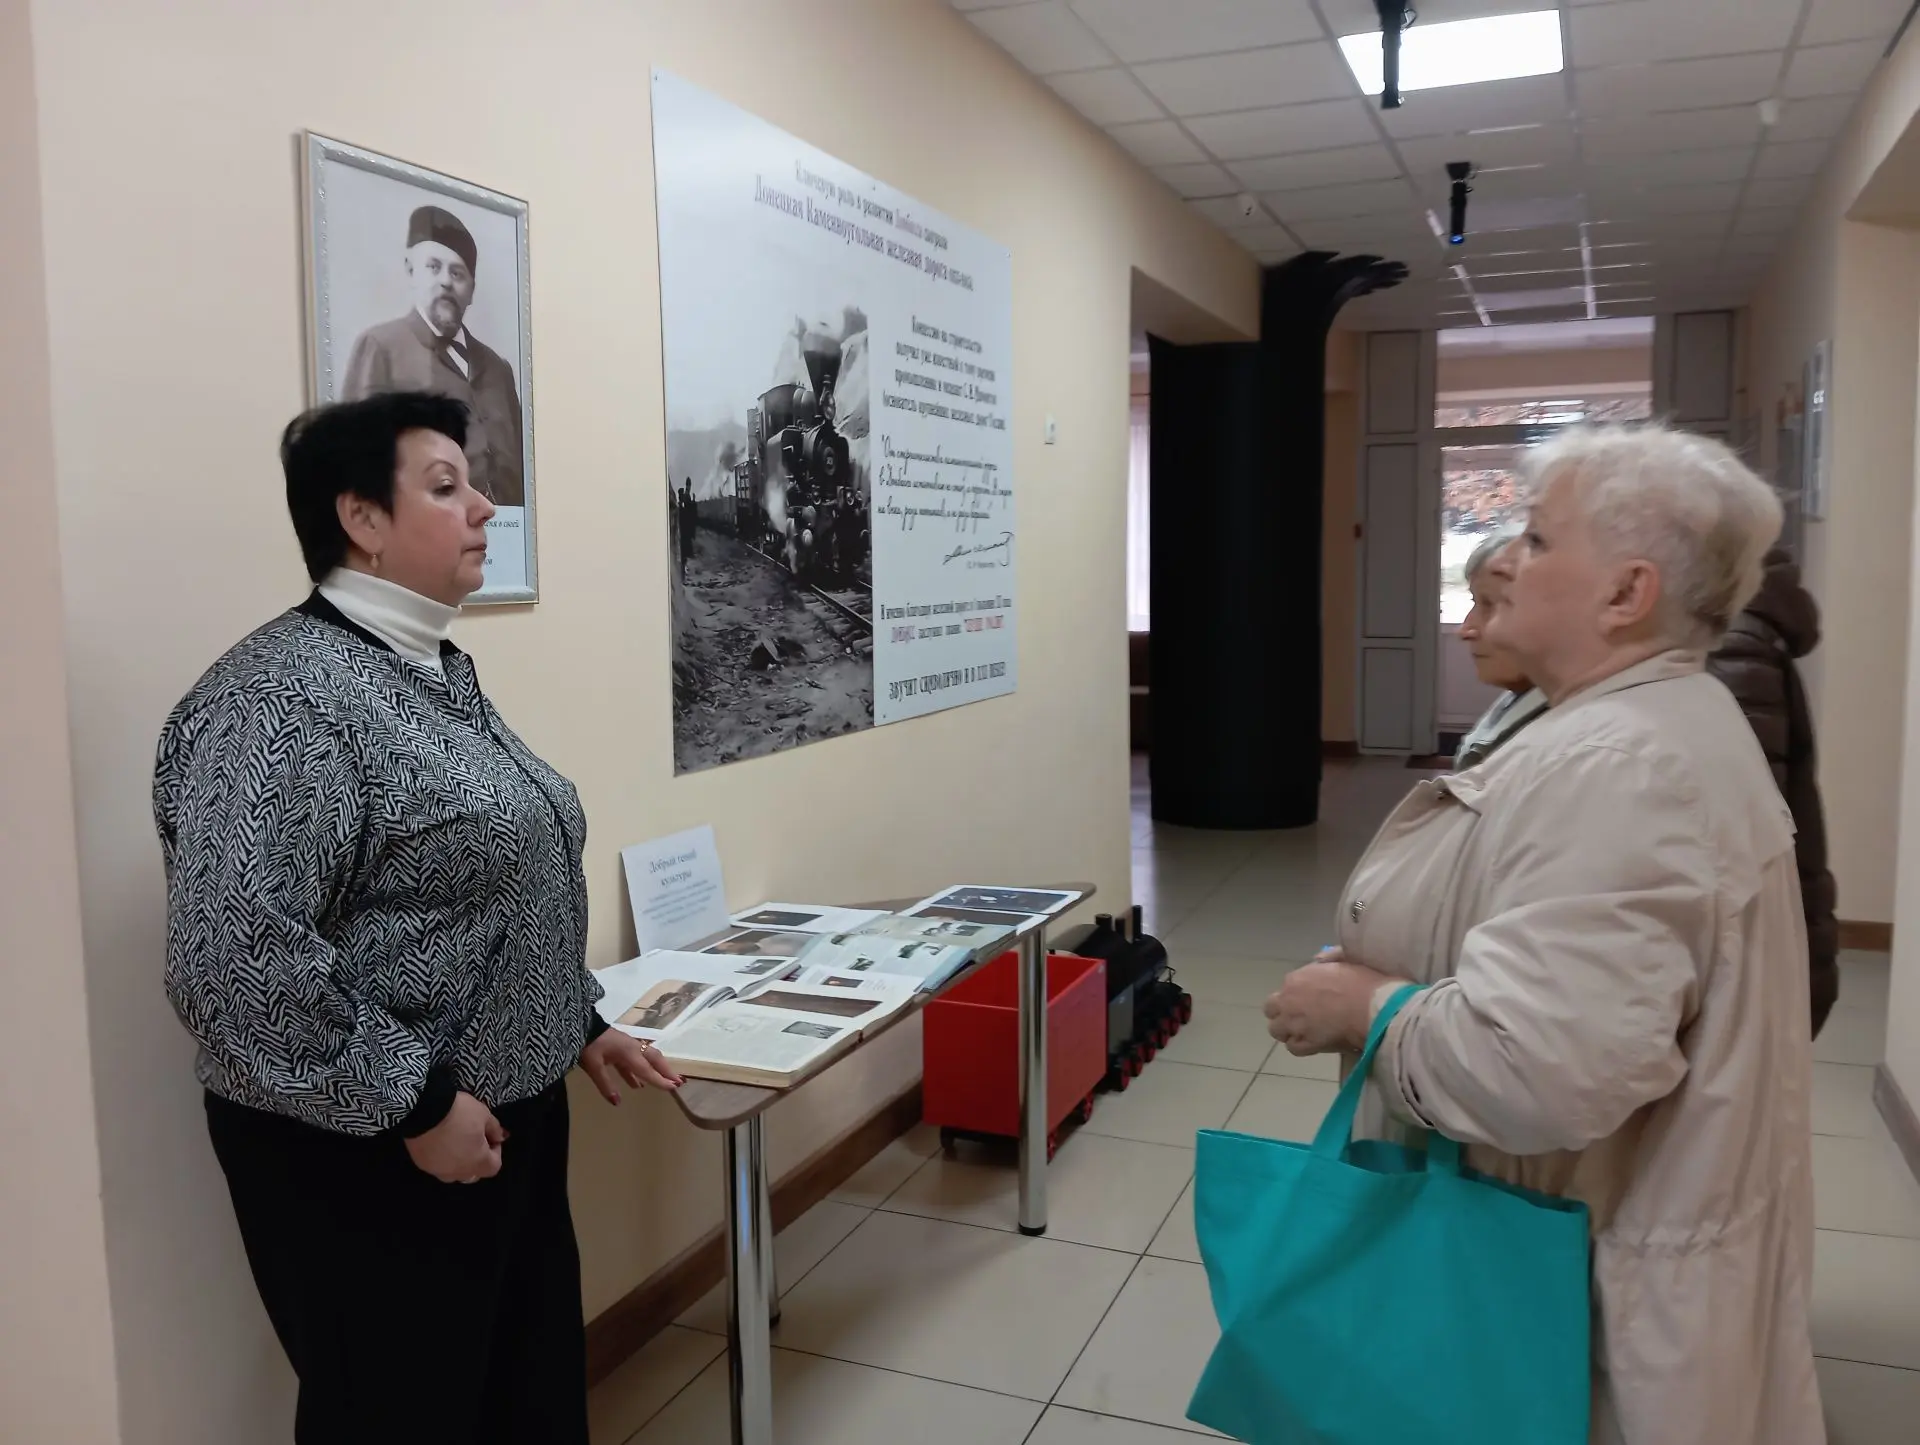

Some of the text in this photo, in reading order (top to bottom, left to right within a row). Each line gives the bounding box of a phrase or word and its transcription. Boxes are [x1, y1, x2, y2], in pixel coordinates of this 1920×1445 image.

[755, 174, 804, 219] Донецкая
[806, 196, 885, 254] Каменноугольная
[889, 677, 918, 702] ЗВУЧИТ
